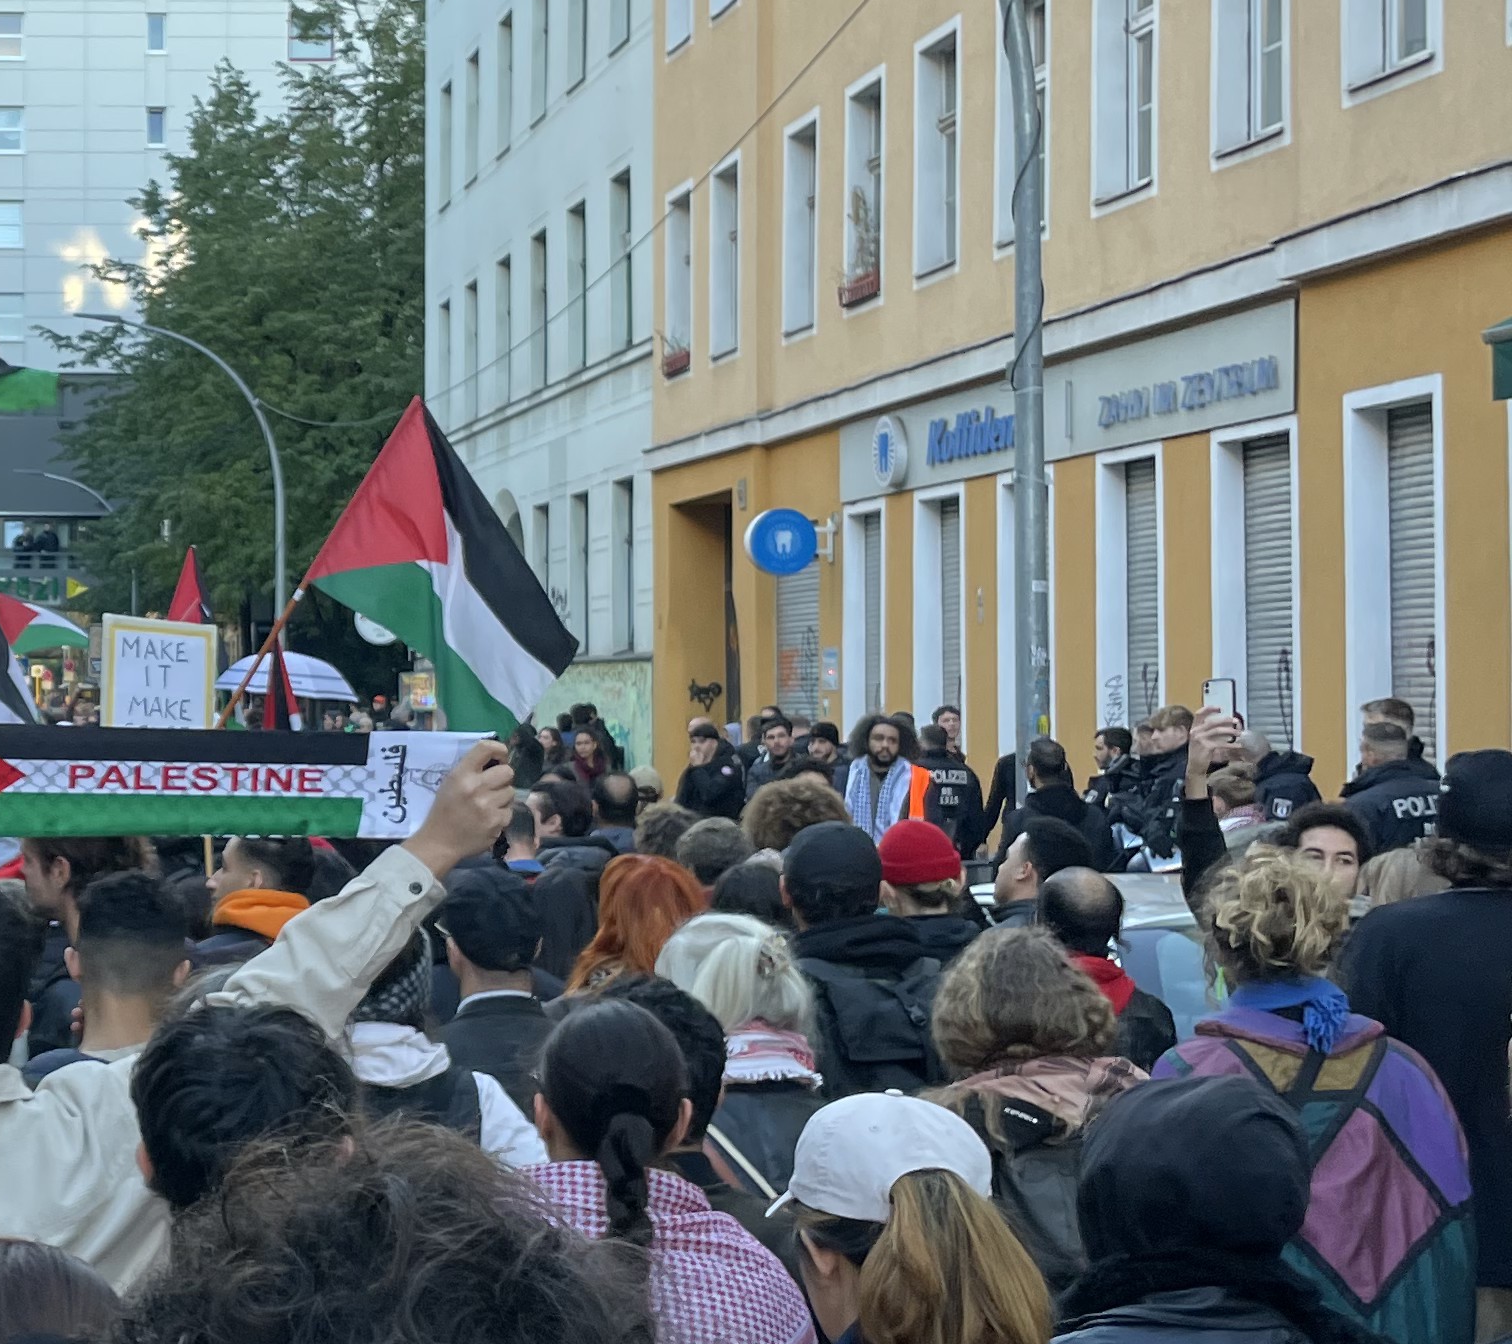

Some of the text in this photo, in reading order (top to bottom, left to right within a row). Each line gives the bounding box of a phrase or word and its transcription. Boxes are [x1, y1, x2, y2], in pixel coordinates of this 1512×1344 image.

[121, 636, 189, 663] MAKE
[144, 664, 172, 689] IT
[128, 696, 192, 722] MAKE
[67, 764, 324, 793] PALESTINE
[1392, 794, 1439, 819] POLI
